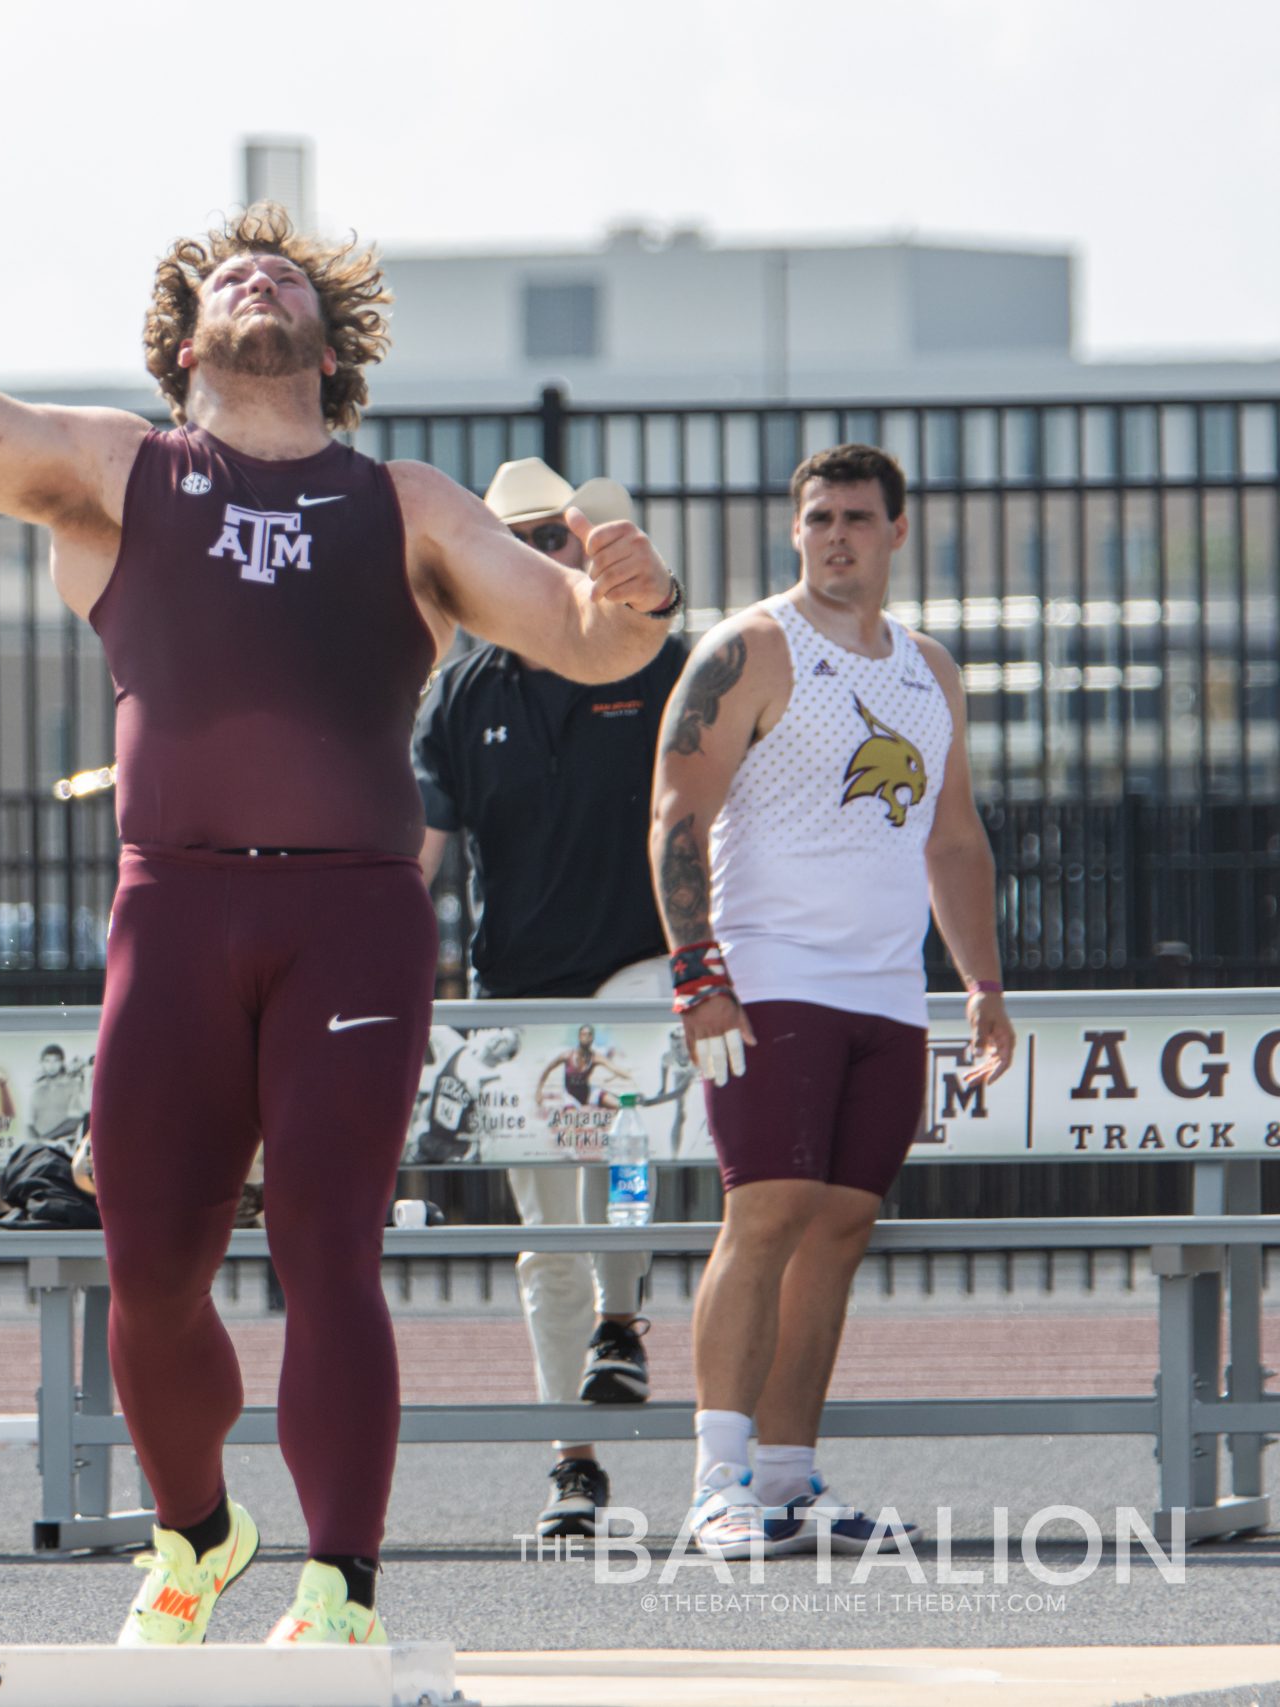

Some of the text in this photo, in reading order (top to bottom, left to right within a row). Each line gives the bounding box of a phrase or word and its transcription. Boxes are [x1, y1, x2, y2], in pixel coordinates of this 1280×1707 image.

[183, 473, 210, 493] SEC
[478, 1092, 520, 1107] Mike
[469, 1113, 527, 1130] Stulce
[552, 1110, 613, 1127] Anjane
[556, 1131, 610, 1147] Kirkla
[1070, 1122, 1235, 1149] TRACK
[151, 1586, 202, 1623] NIK
